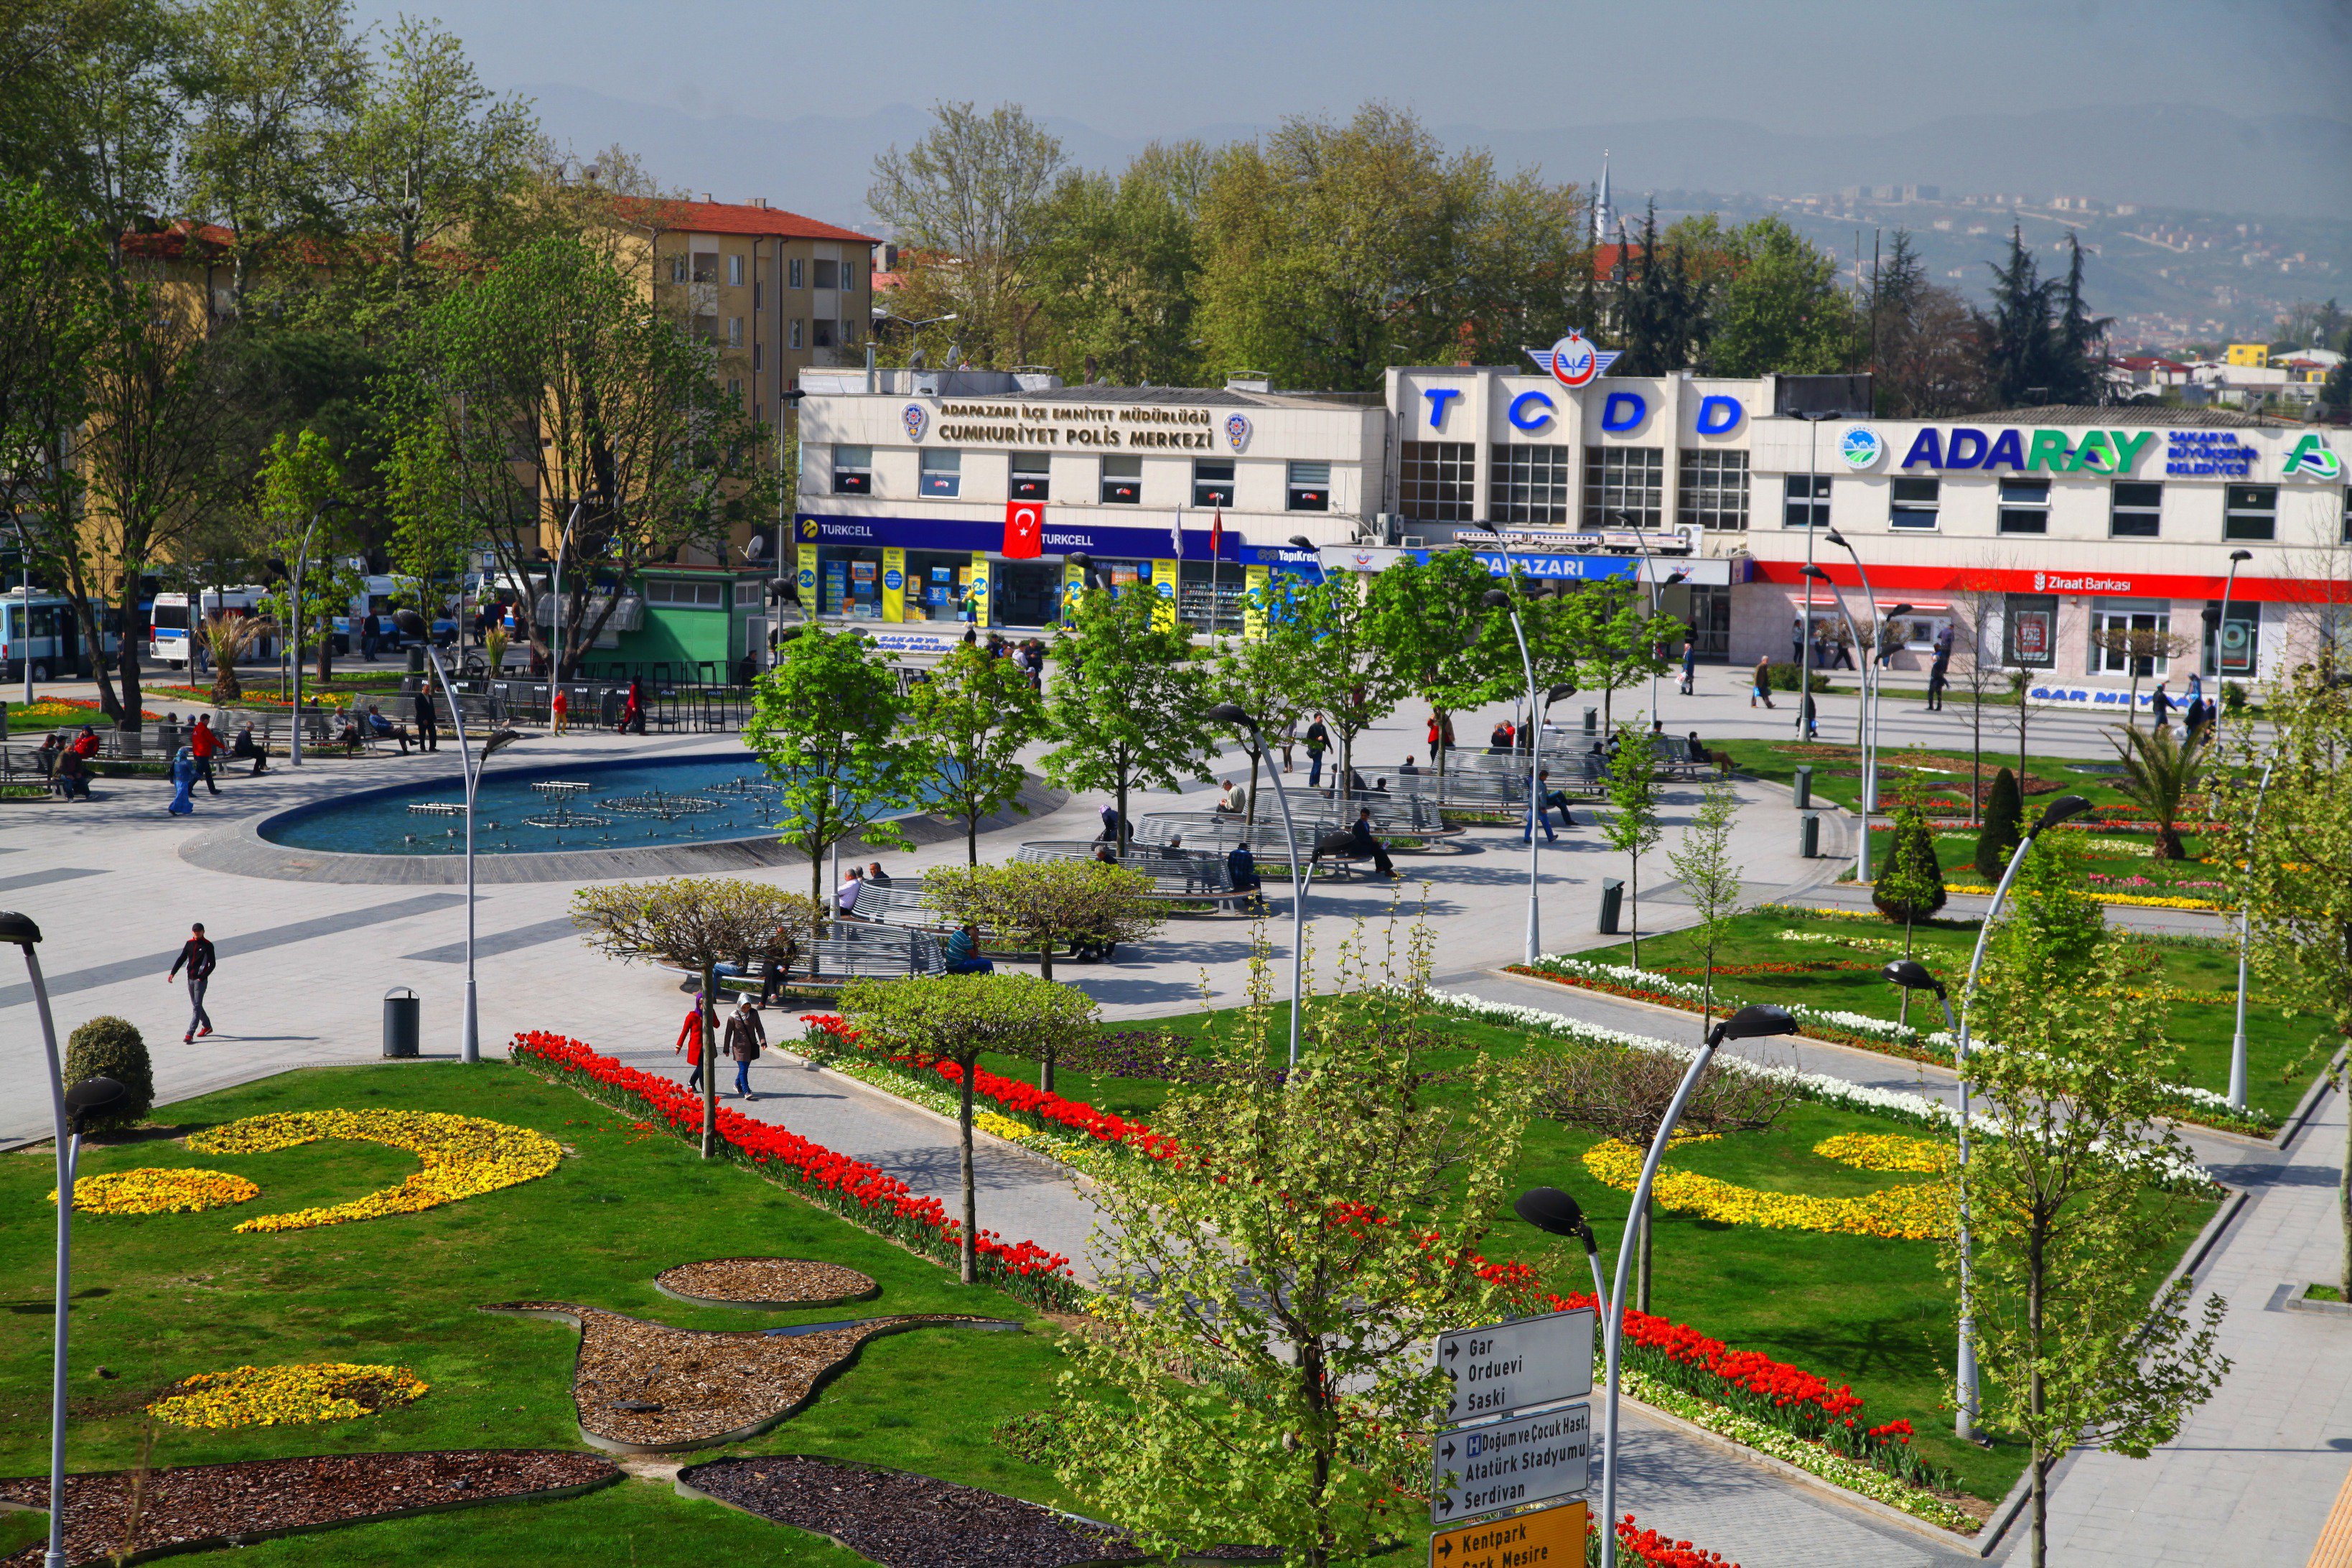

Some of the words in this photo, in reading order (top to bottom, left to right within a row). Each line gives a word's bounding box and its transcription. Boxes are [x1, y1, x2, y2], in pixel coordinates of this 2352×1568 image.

[941, 403, 1017, 419] ADAPAZARI
[1021, 403, 1048, 422] İLÇE
[1052, 405, 1115, 422] EMNİYET
[1119, 406, 1212, 425] MÜDÜRLÜĞÜ
[1424, 388, 1742, 435] TCDD
[938, 422, 1059, 444] CUMHURİYET
[1065, 424, 1121, 445] POLİS
[1129, 427, 1214, 449] MERKEZİ
[2168, 431, 2238, 443] SAKARYA
[1900, 427, 2155, 475] ADARAY
[2167, 444, 2259, 462] BÜYÜKŞEHİR
[2165, 460, 2249, 475] BELEDİYESİ
[821, 524, 873, 536] TURKCELL
[1041, 533, 1093, 546] TURKCELL
[1278, 549, 1319, 563] YapıKred
[1474, 556, 1584, 576] DAPAZARI
[800, 574, 814, 584] 24
[974, 582, 987, 591] 24
[2048, 576, 2083, 590] Ziraat
[2085, 577, 2131, 592] Bankası
[1469, 1338, 1493, 1357] Gar
[1468, 1354, 1523, 1382] Orduevi
[1467, 1386, 1506, 1411] Saski
[1482, 1431, 1516, 1453] Doğum
[1518, 1429, 1529, 1445] ve
[1531, 1419, 1561, 1444] Çocuk
[1563, 1414, 1588, 1435] Hast.
[1465, 1455, 1518, 1483] Atatürk
[1521, 1443, 1586, 1470] Stadyumu
[1465, 1483, 1525, 1510] Serdivan
[1462, 1523, 1527, 1554] Kentpark
[1503, 1545, 1548, 1568] Mesire
